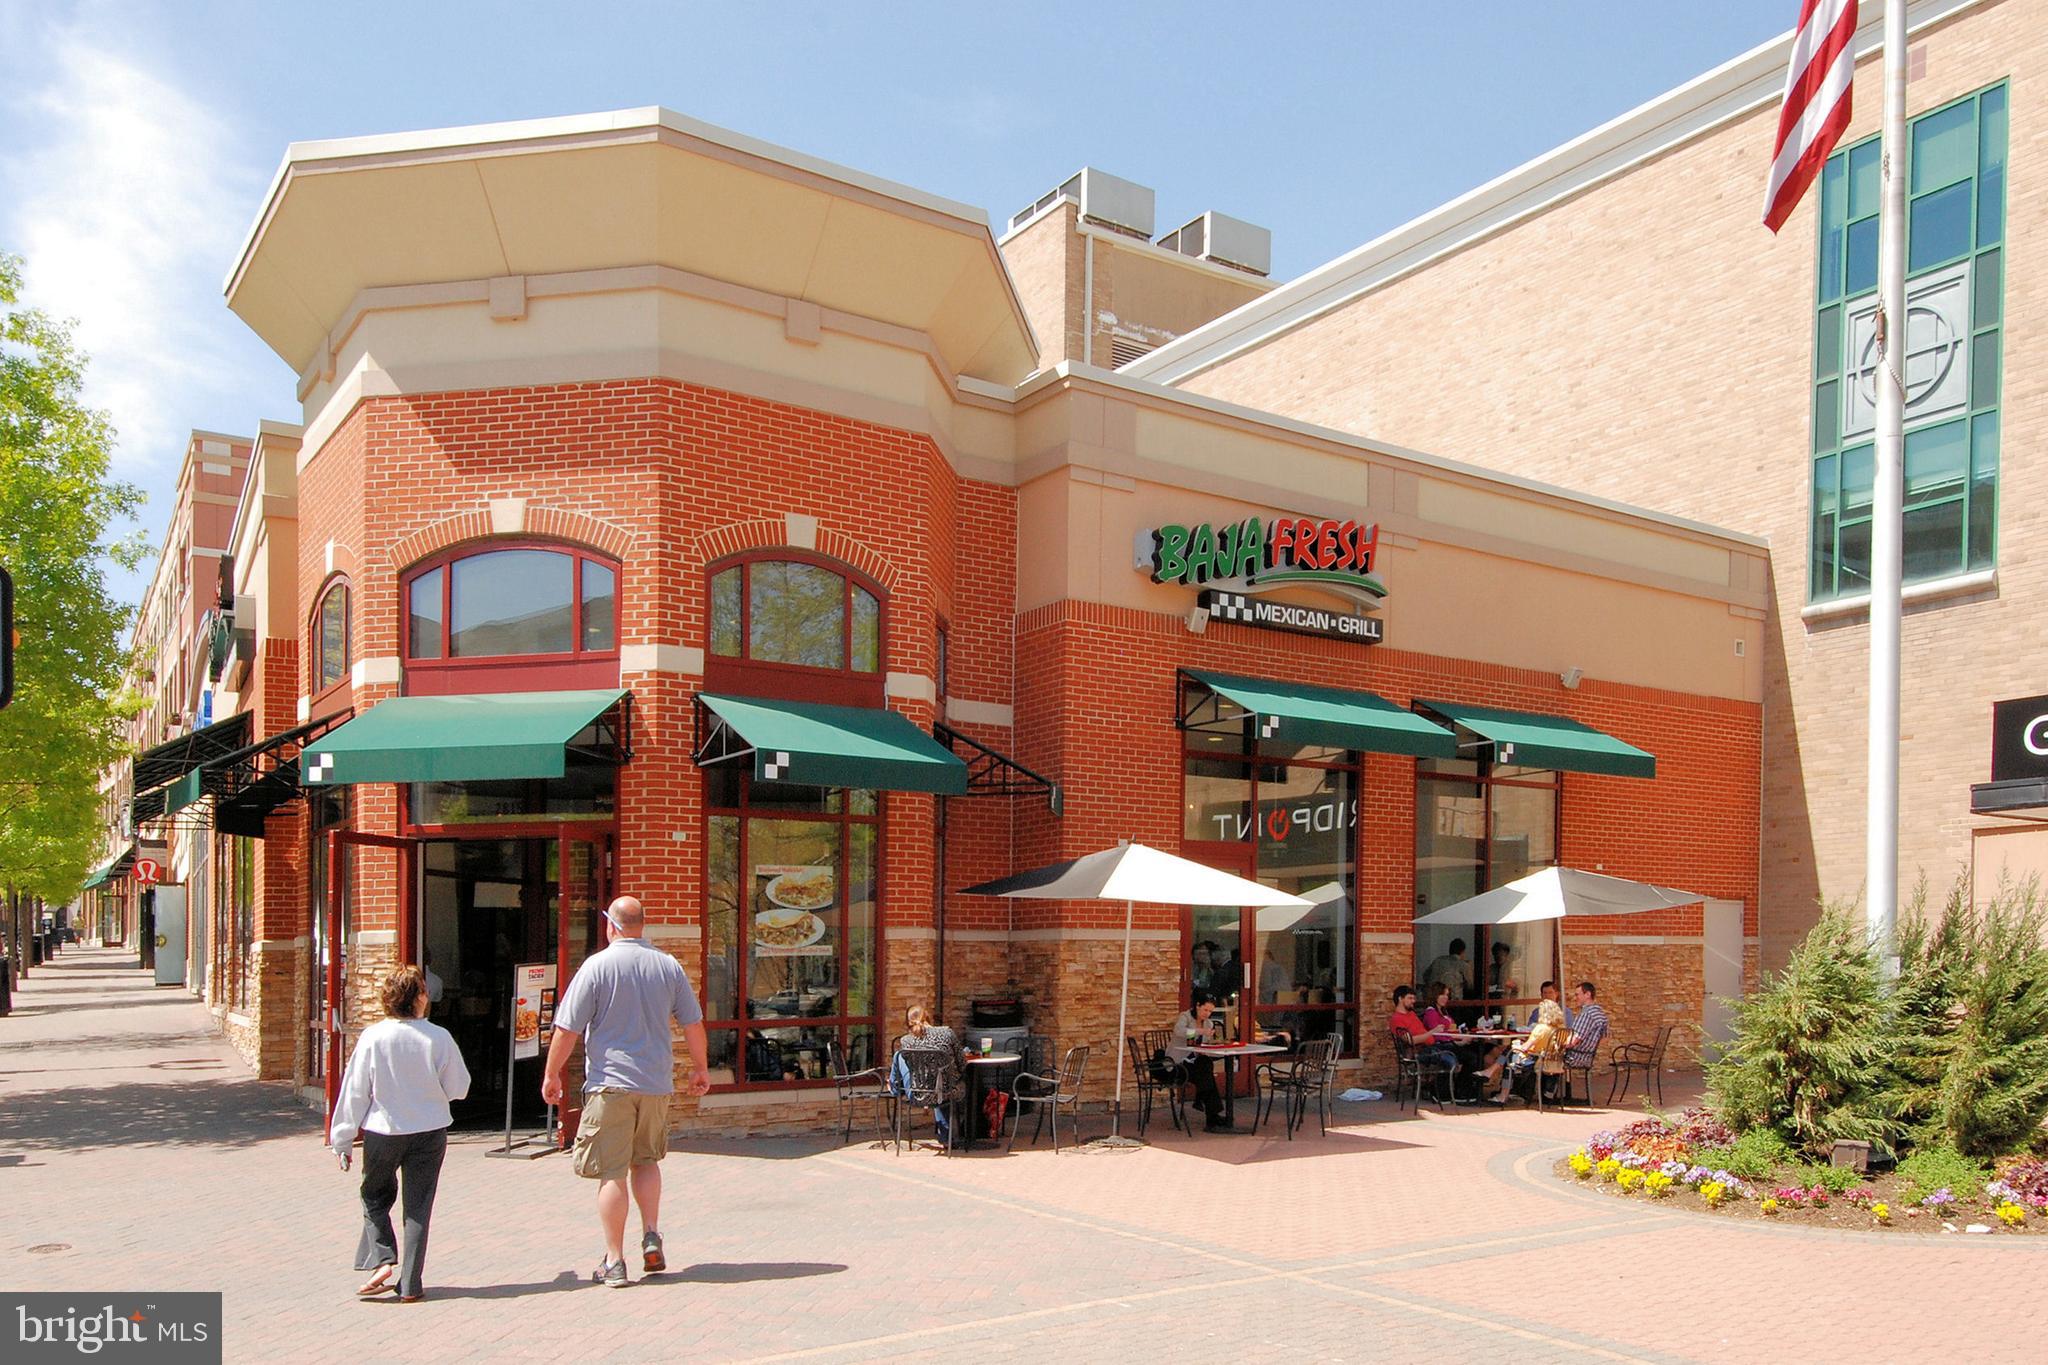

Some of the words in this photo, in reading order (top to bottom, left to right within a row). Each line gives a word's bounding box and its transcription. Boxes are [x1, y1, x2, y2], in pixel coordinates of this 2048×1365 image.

[1156, 516, 1265, 585] BAJA
[1268, 517, 1380, 574] FRESH
[1255, 602, 1330, 631] MEXICAN
[1337, 616, 1381, 638] GRILL
